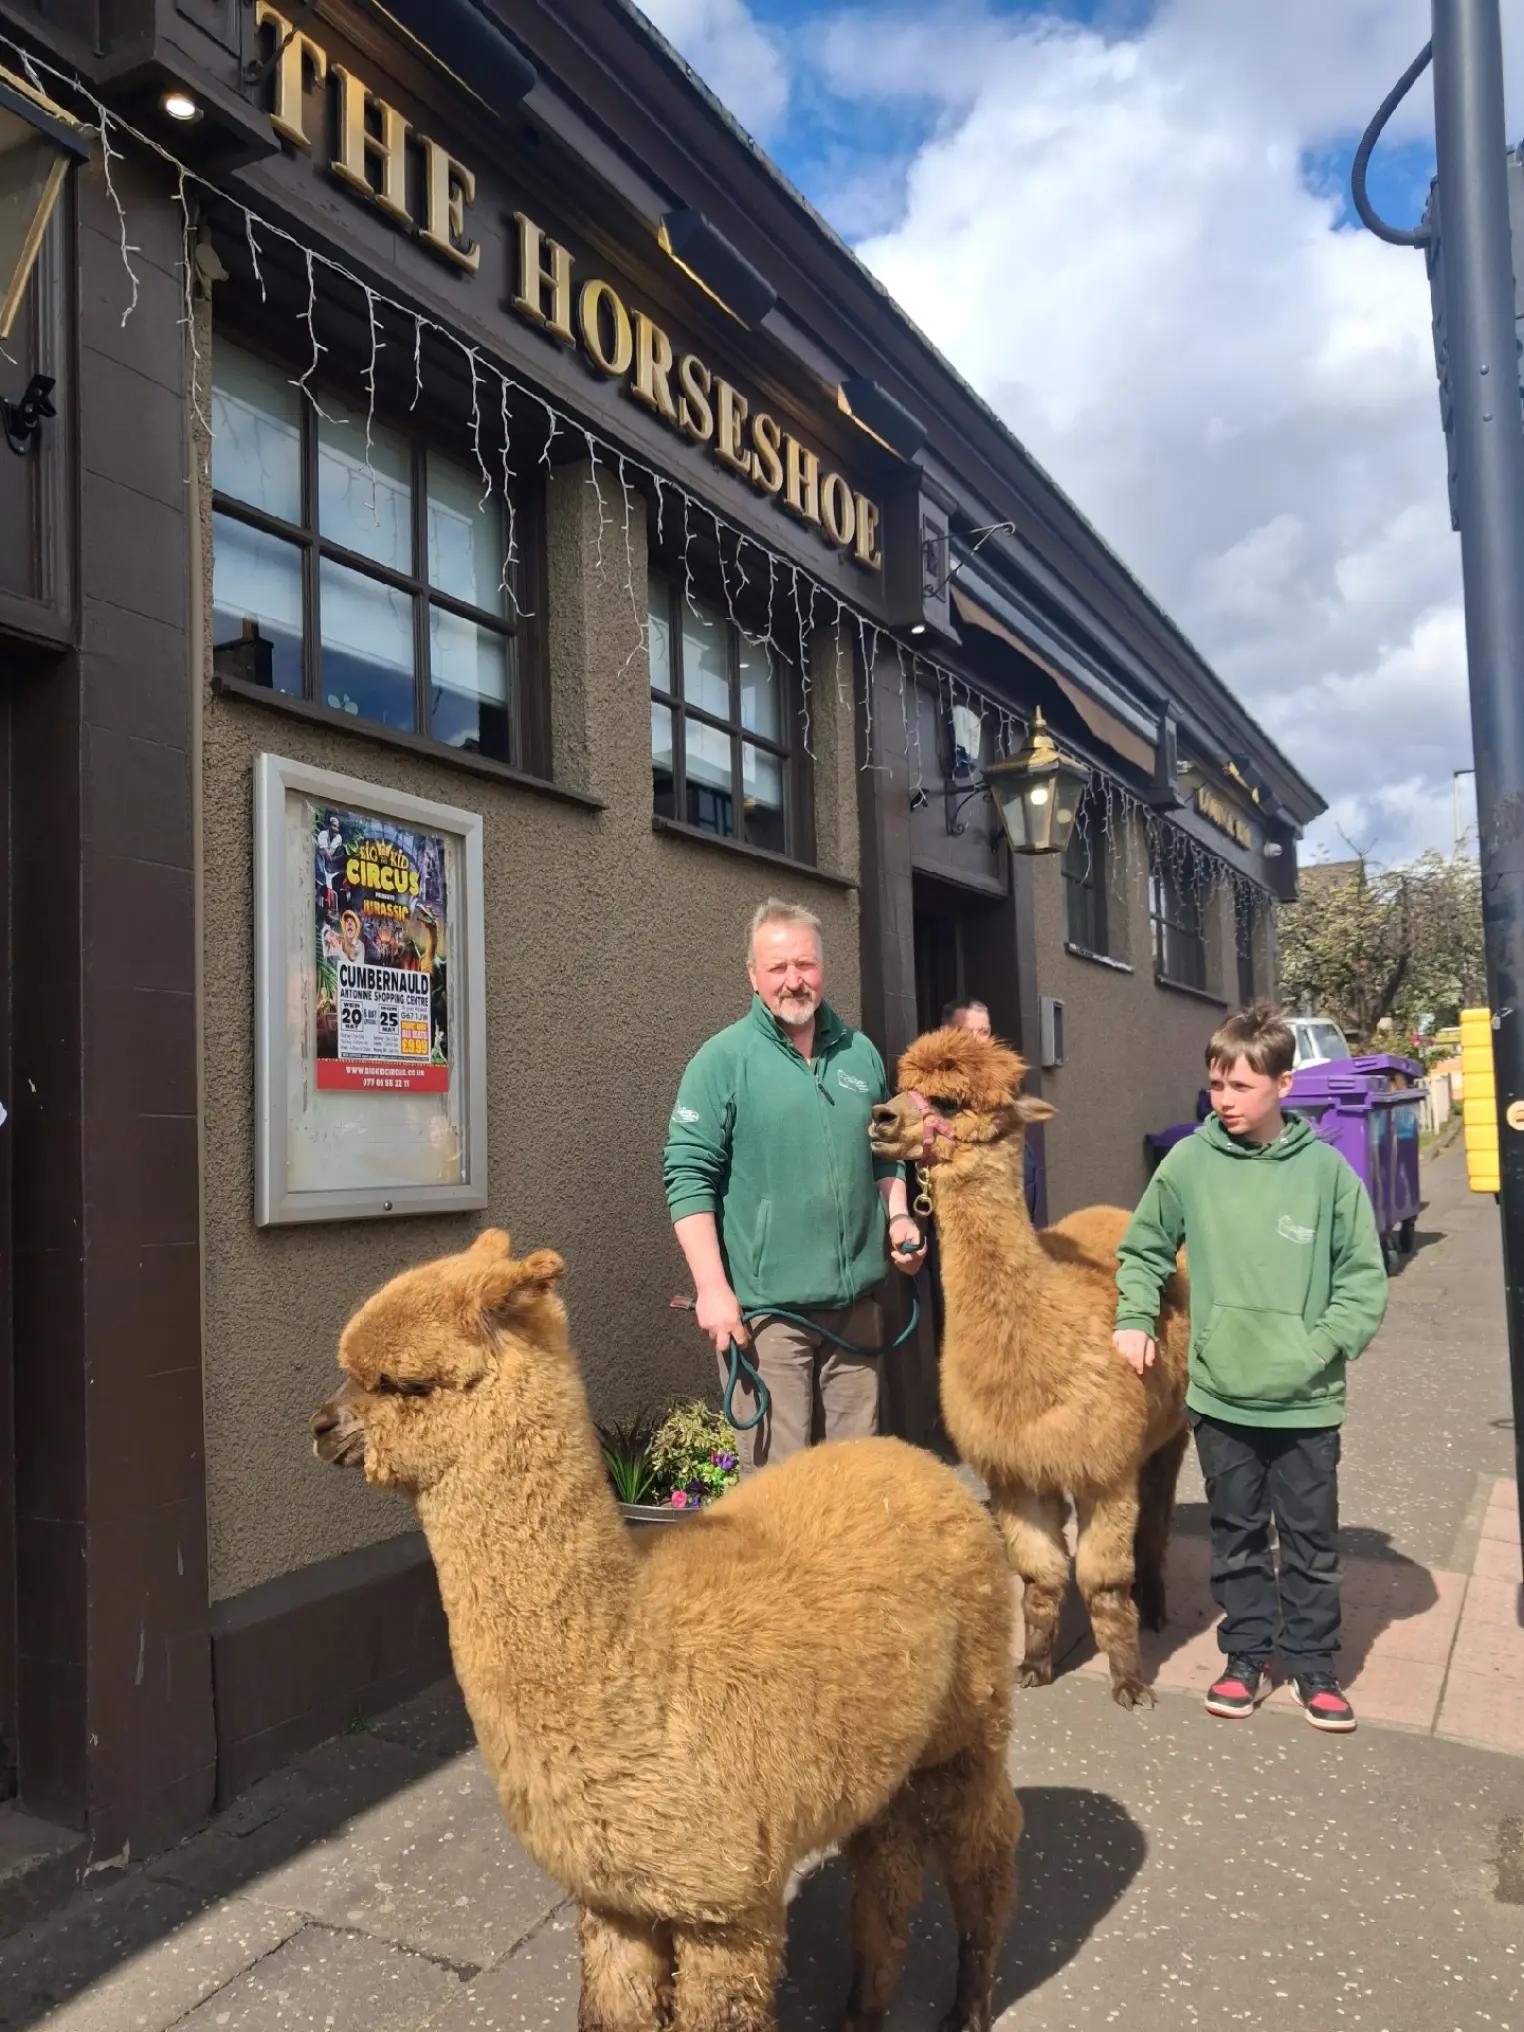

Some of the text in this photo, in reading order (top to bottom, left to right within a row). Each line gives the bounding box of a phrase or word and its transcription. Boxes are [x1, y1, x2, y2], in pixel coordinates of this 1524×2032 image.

[254, 3, 883, 571] THE HORSESHOE
[360, 841, 409, 869] BIG KID
[346, 858, 419, 896] CIRCUS
[363, 899, 409, 921] JURASSIC
[340, 964, 429, 995] CUMBERNAULD
[374, 991, 405, 1004] SHOPPING
[406, 995, 429, 1007] CENTRE
[342, 1008, 362, 1025] 20
[380, 1012, 398, 1027] 25
